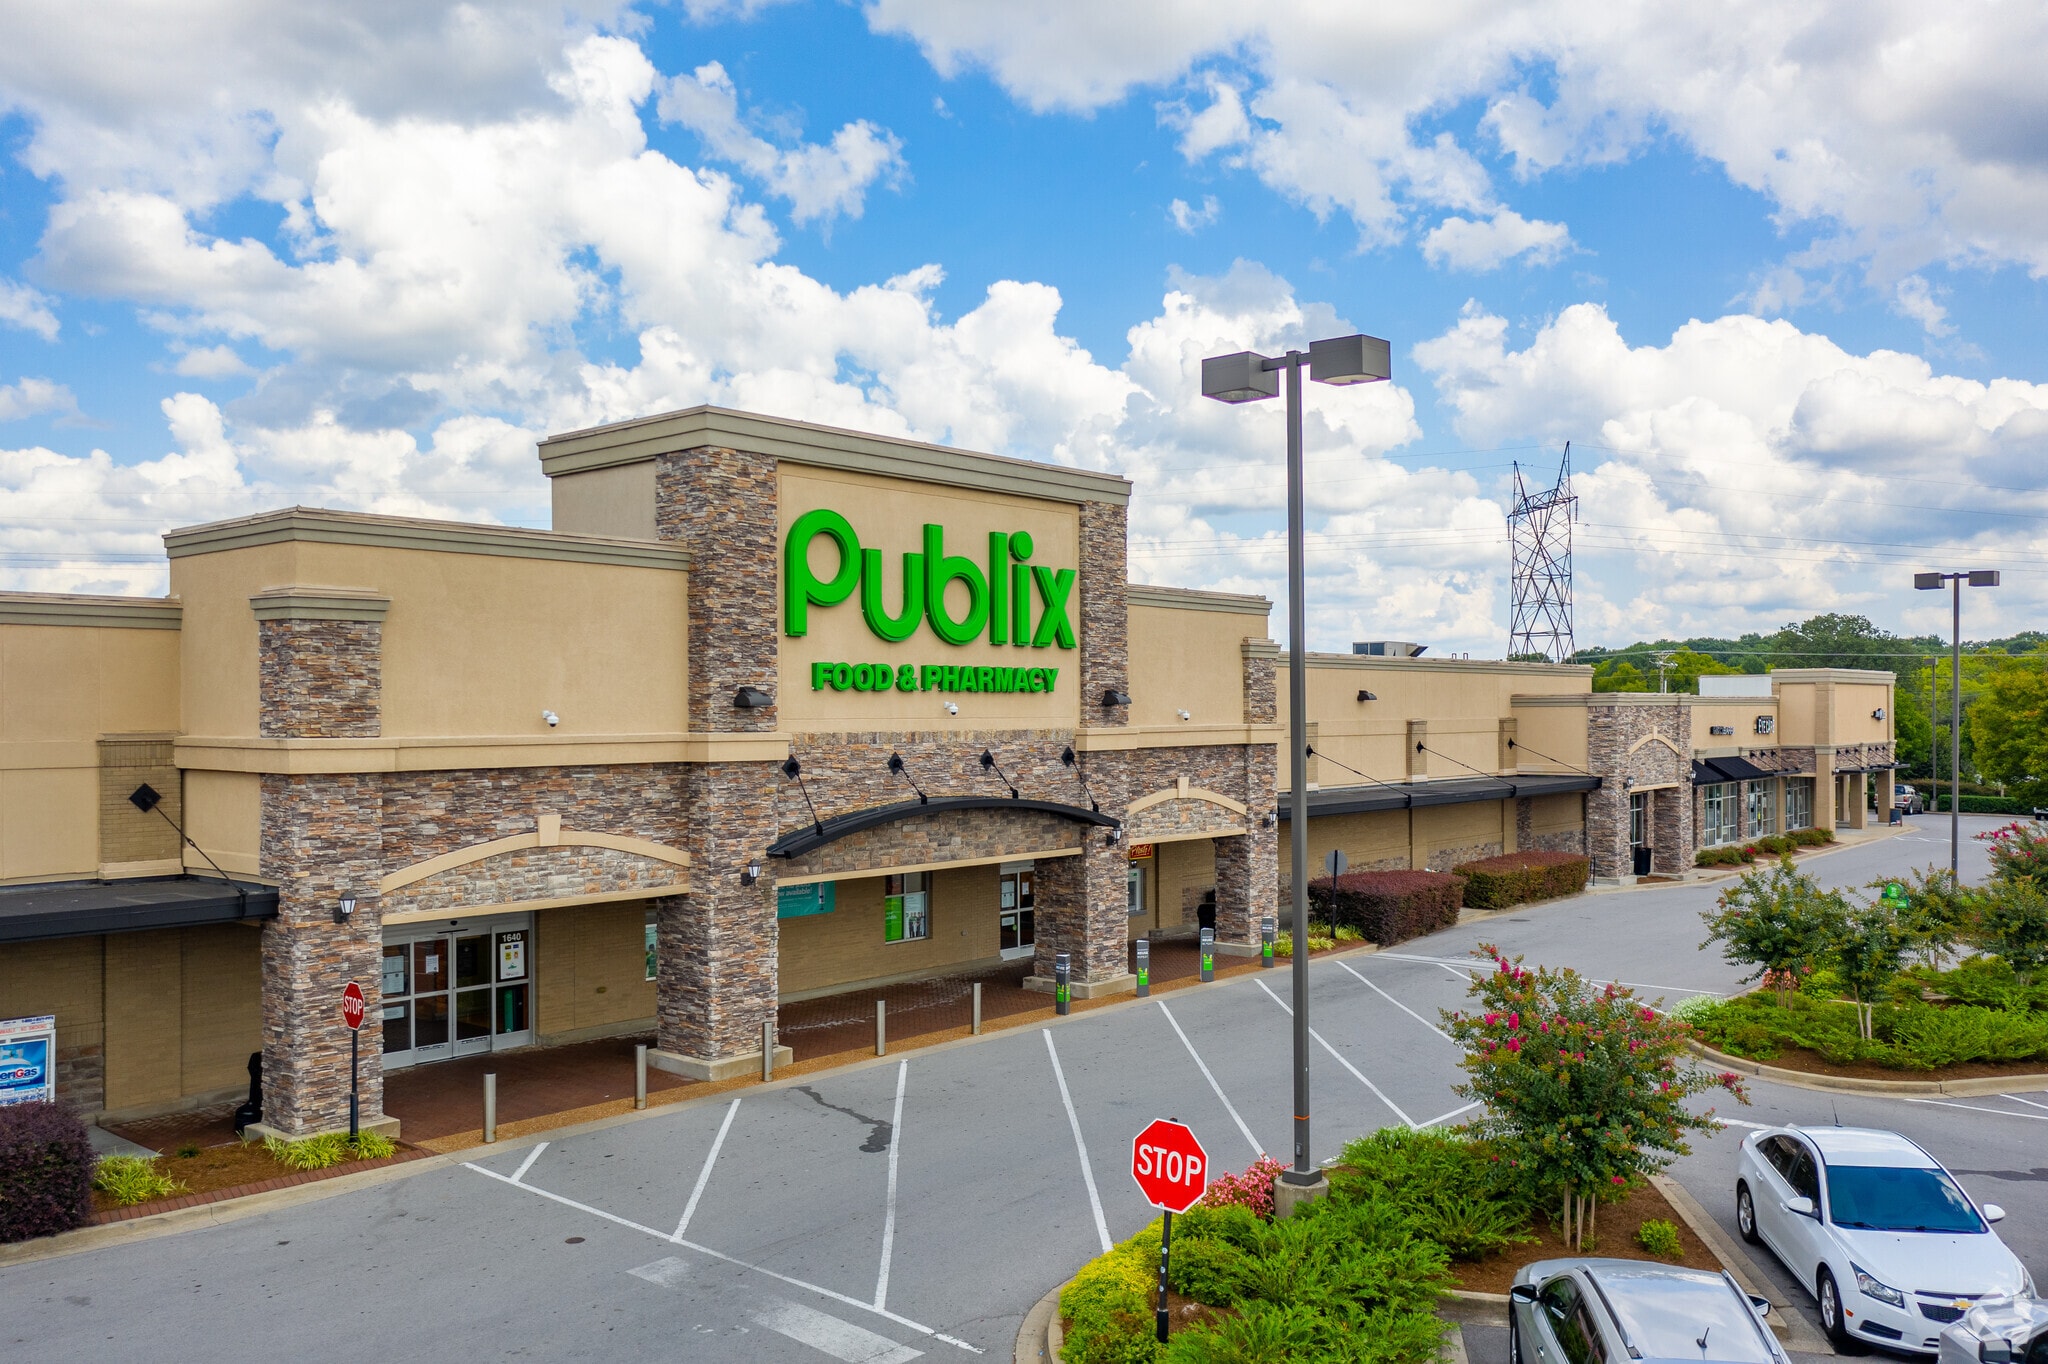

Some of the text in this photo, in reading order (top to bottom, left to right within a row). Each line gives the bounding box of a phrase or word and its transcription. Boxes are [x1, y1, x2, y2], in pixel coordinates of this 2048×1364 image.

[784, 508, 1077, 649] Publix
[811, 662, 1059, 692] FOOD & PHARMACY
[502, 933, 521, 942] 1640
[344, 995, 363, 1015] STOP
[0, 1068, 37, 1080] eriGas
[1137, 1143, 1202, 1187] STOP
